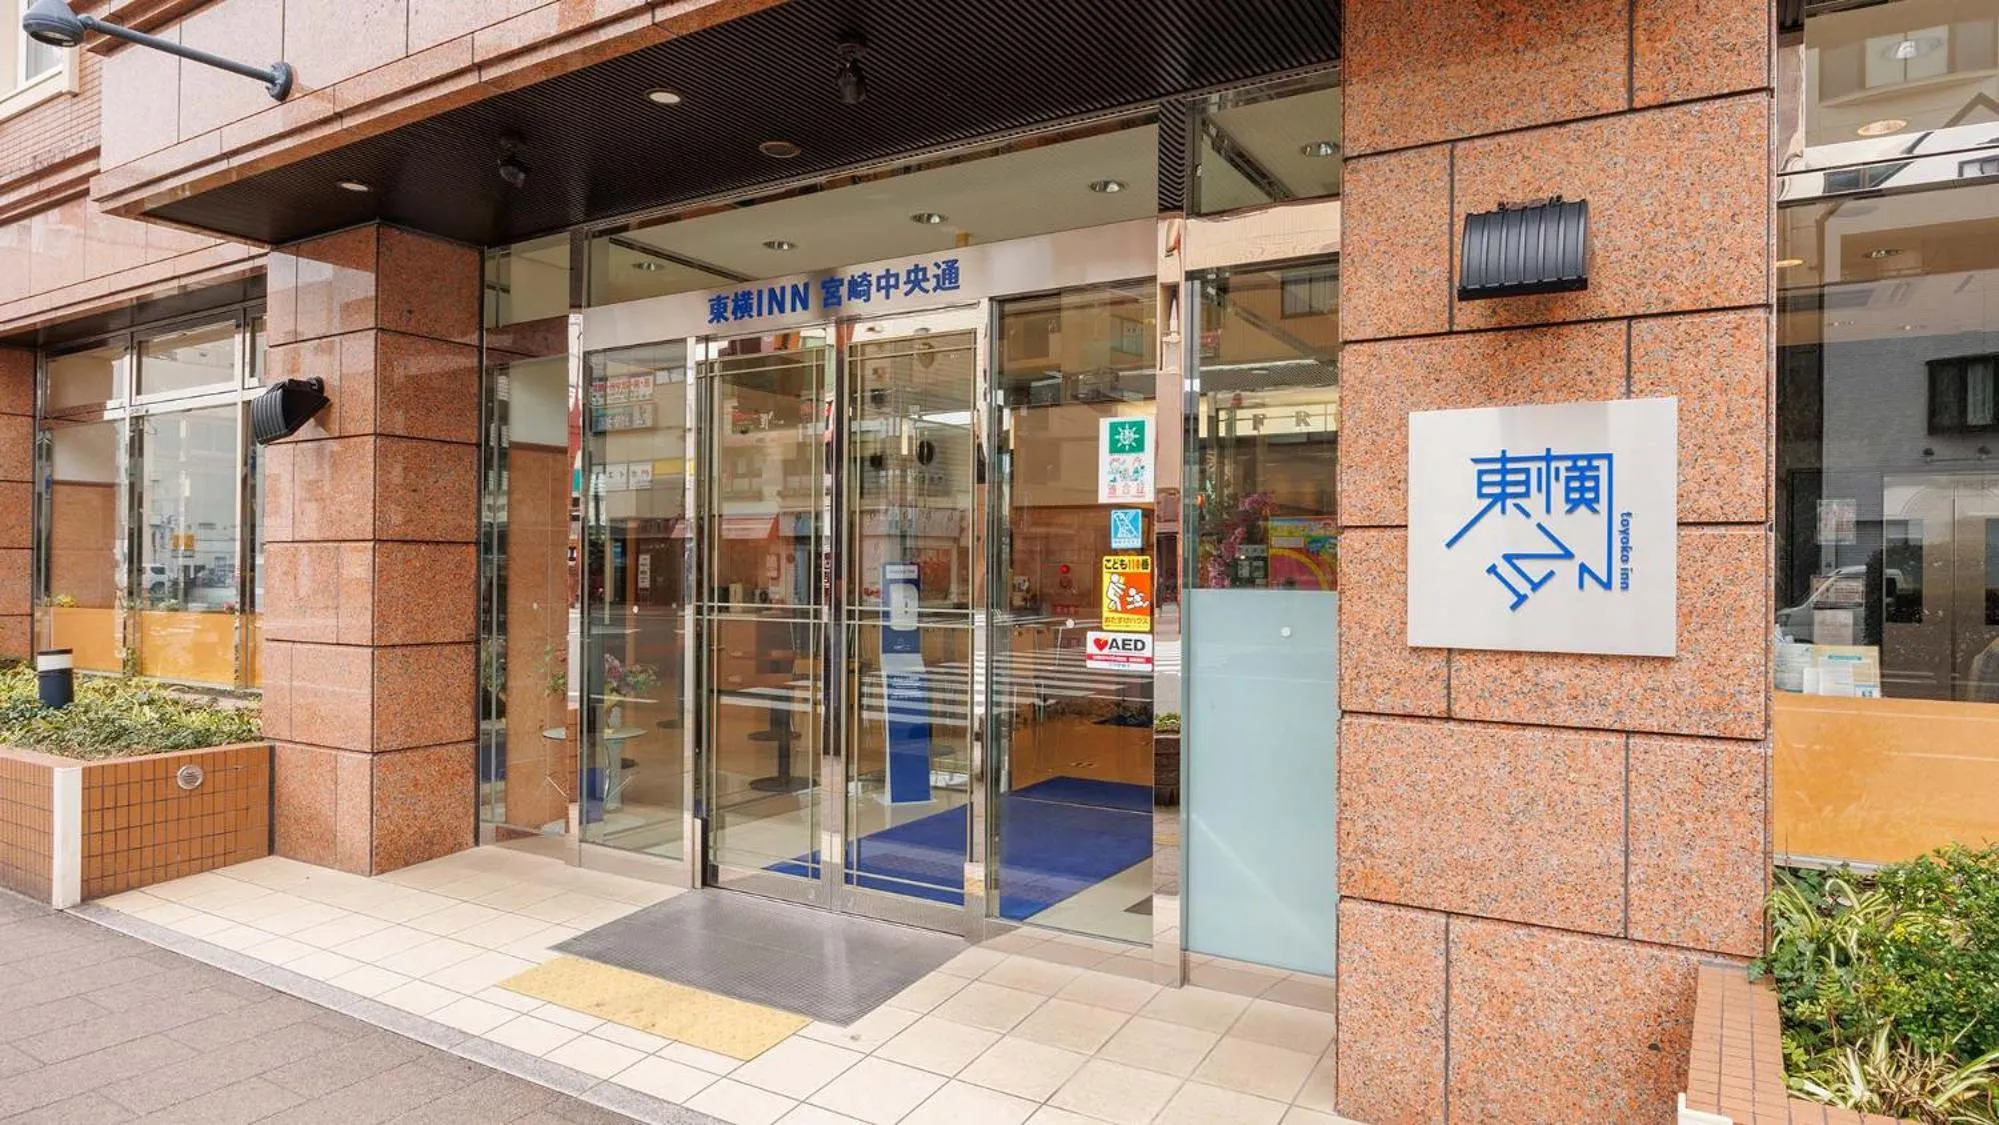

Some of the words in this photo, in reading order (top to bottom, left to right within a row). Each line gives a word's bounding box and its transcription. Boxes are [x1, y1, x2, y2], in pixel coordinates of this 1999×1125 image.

[707, 281, 810, 324] 東横INN
[821, 259, 961, 309] 宮崎中央通
[1619, 511, 1633, 565] toyoko
[1620, 568, 1633, 591] inn
[1108, 638, 1146, 651] AED
